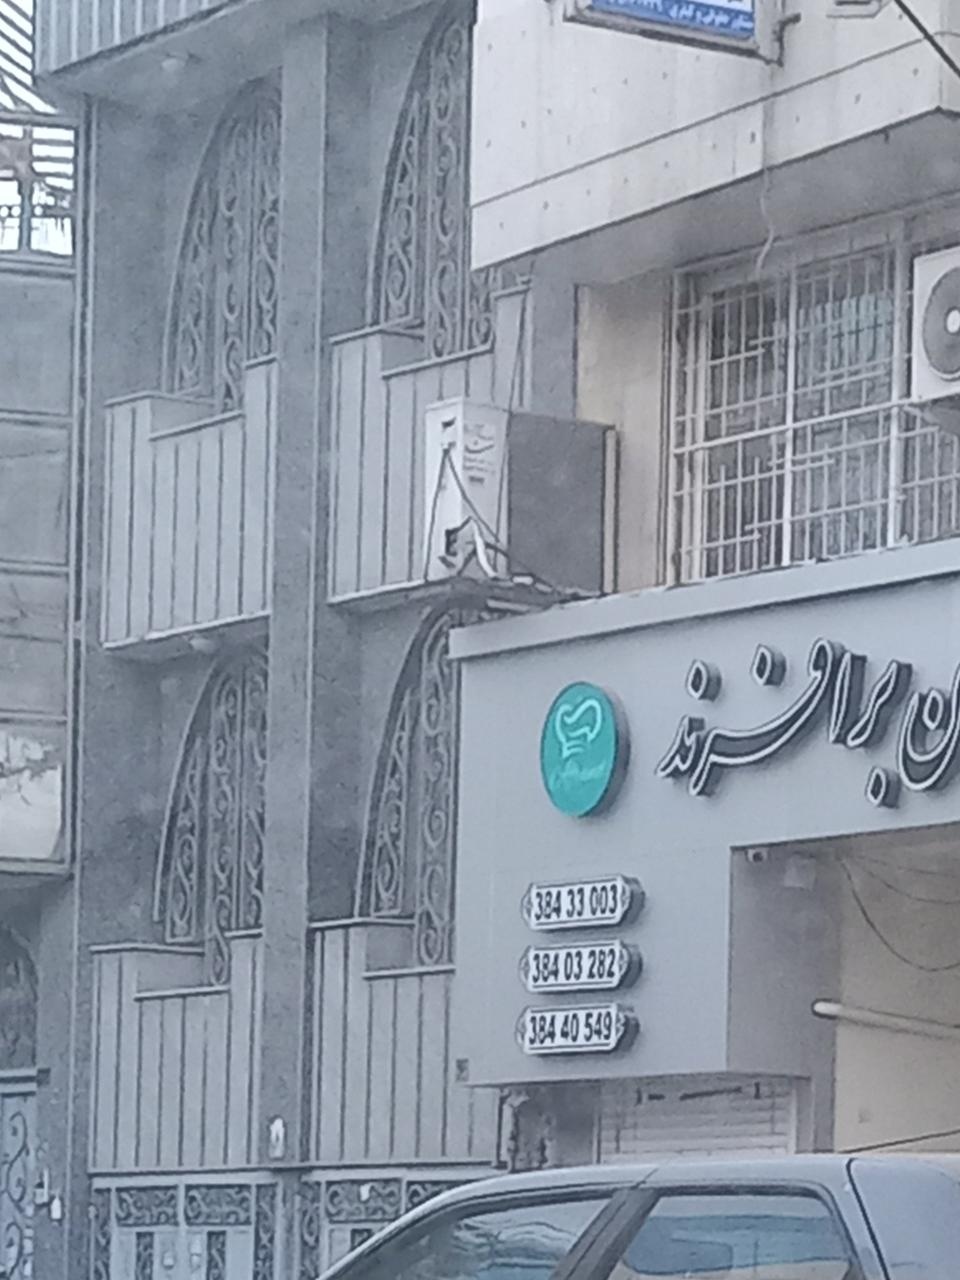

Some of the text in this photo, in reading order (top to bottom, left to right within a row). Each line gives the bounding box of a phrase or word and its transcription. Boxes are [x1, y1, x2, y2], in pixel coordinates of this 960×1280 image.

[534, 883, 618, 921] 384 33 003
[532, 947, 616, 983] 384 03 282
[528, 1010, 613, 1045] 384 40 549
